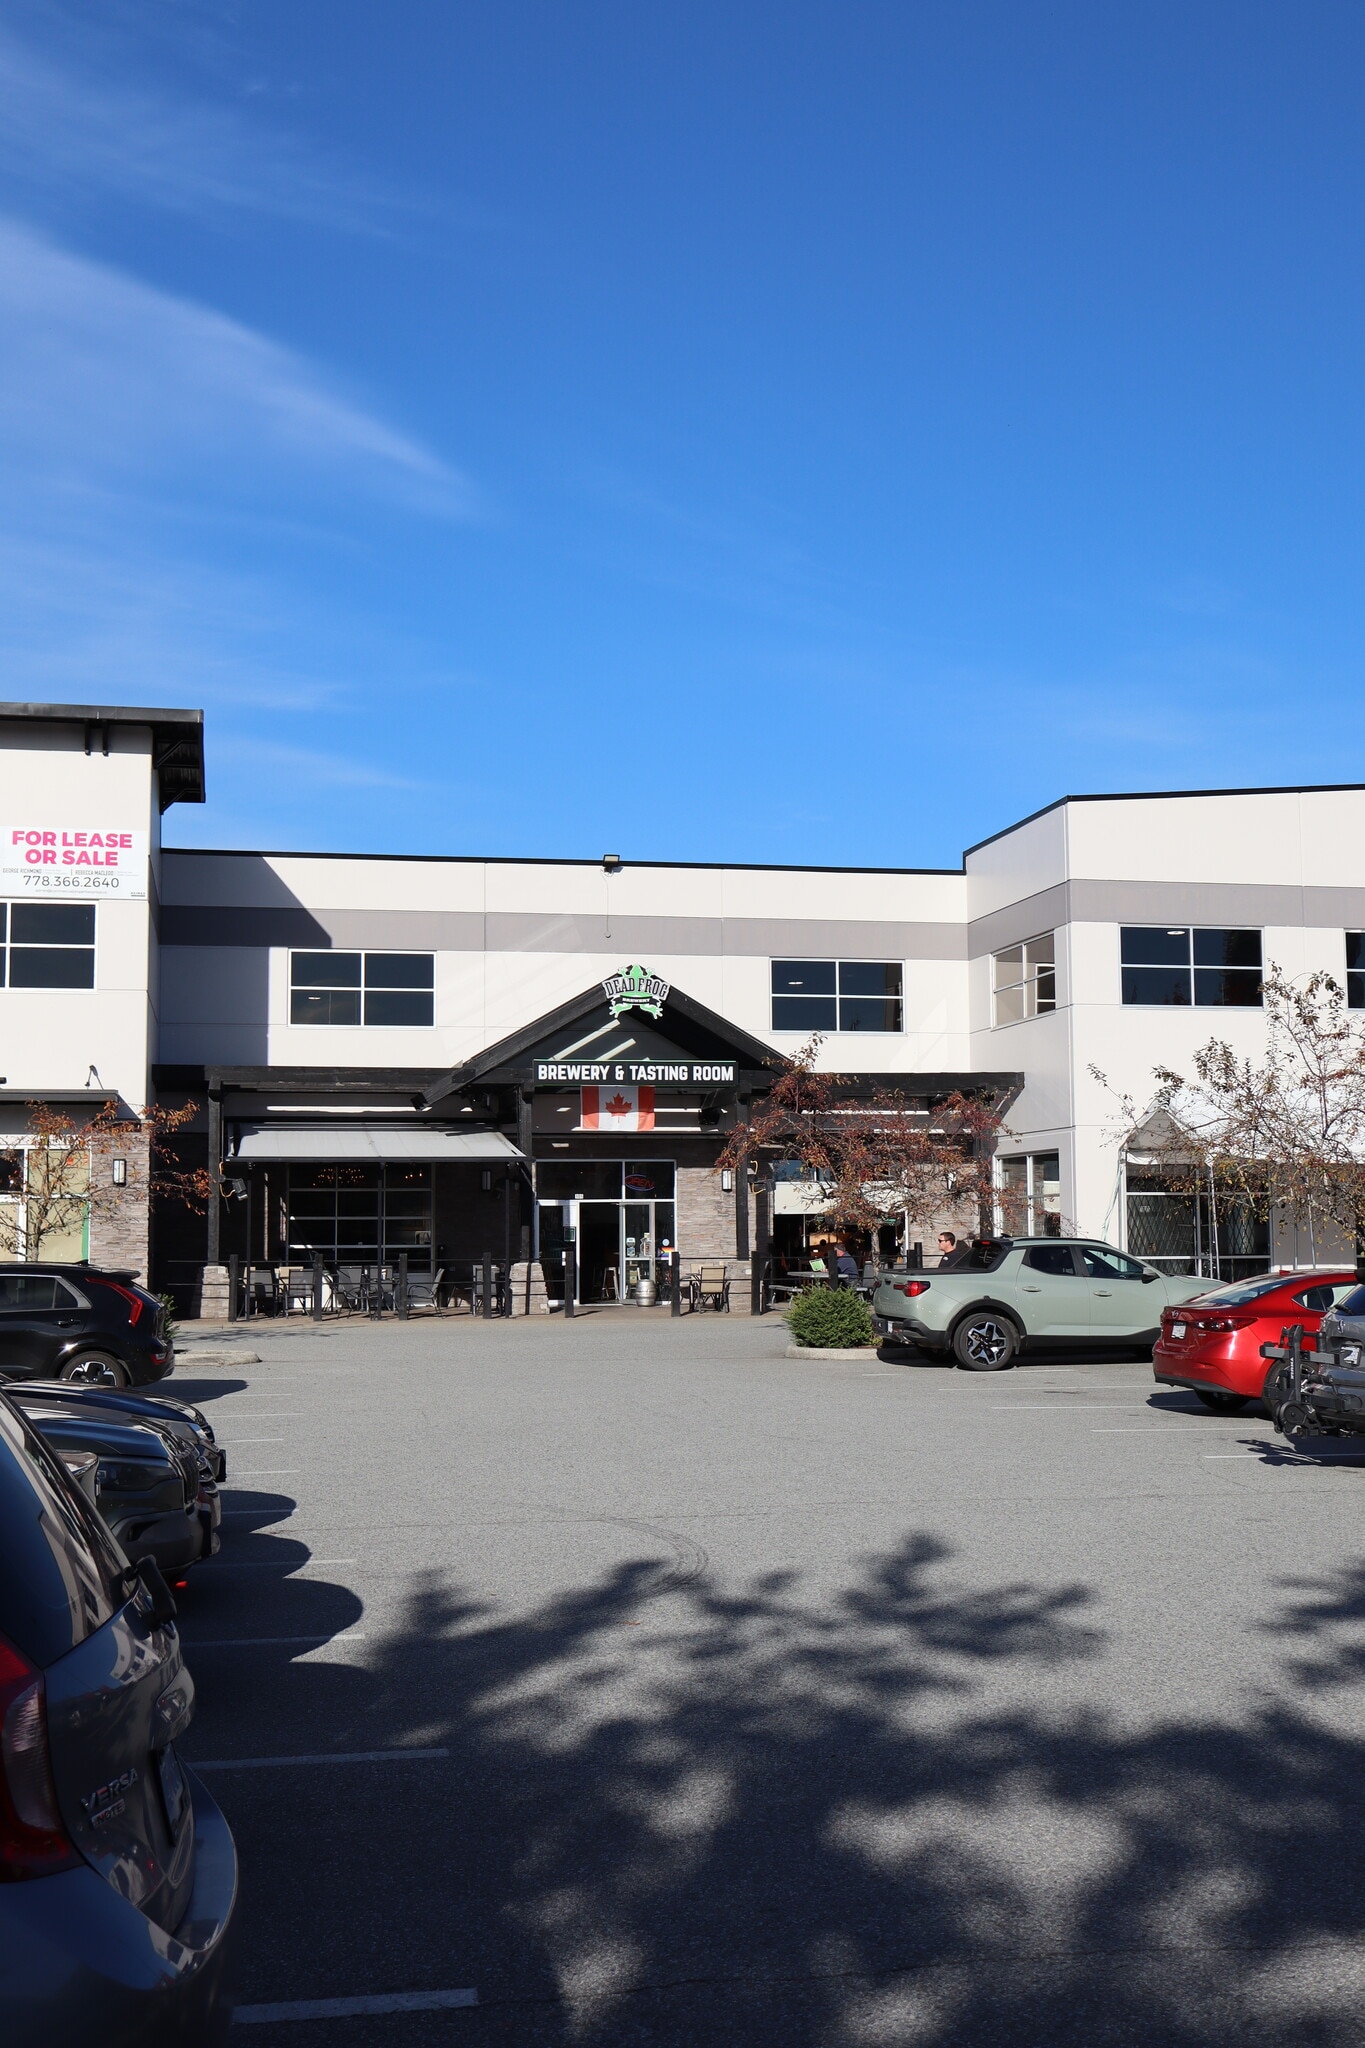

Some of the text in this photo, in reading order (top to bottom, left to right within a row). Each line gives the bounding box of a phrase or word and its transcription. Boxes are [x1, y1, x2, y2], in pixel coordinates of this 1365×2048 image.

[12, 830, 133, 848] FOR LEASE
[25, 849, 119, 866] OR SALE
[23, 875, 120, 888] 778.366.2640
[605, 977, 668, 998] DEAD FROG
[537, 1064, 734, 1081] BREWERY & TASTING ROOM
[80, 1767, 138, 1812] VERSA
